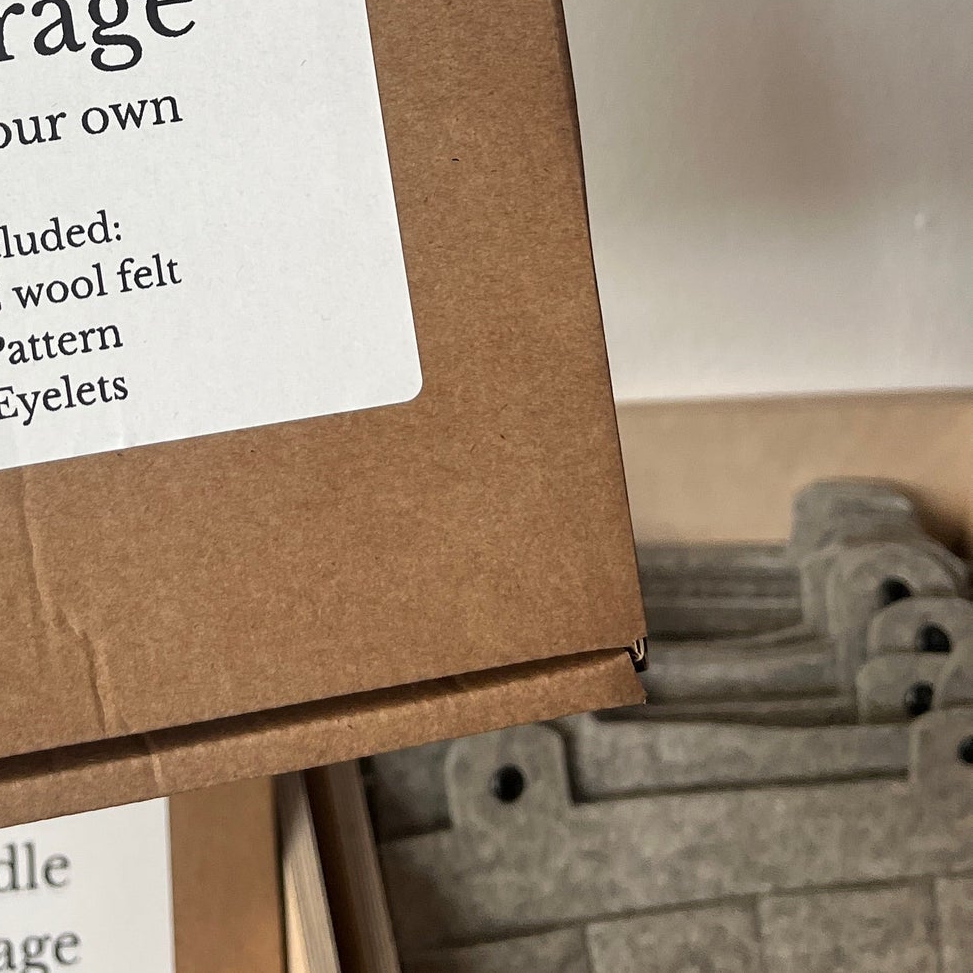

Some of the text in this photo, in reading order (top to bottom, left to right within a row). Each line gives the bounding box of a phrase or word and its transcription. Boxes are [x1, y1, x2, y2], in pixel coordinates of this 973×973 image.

[81, 95, 184, 135] own
[11, 262, 109, 309] wool
[116, 253, 183, 293] felt
